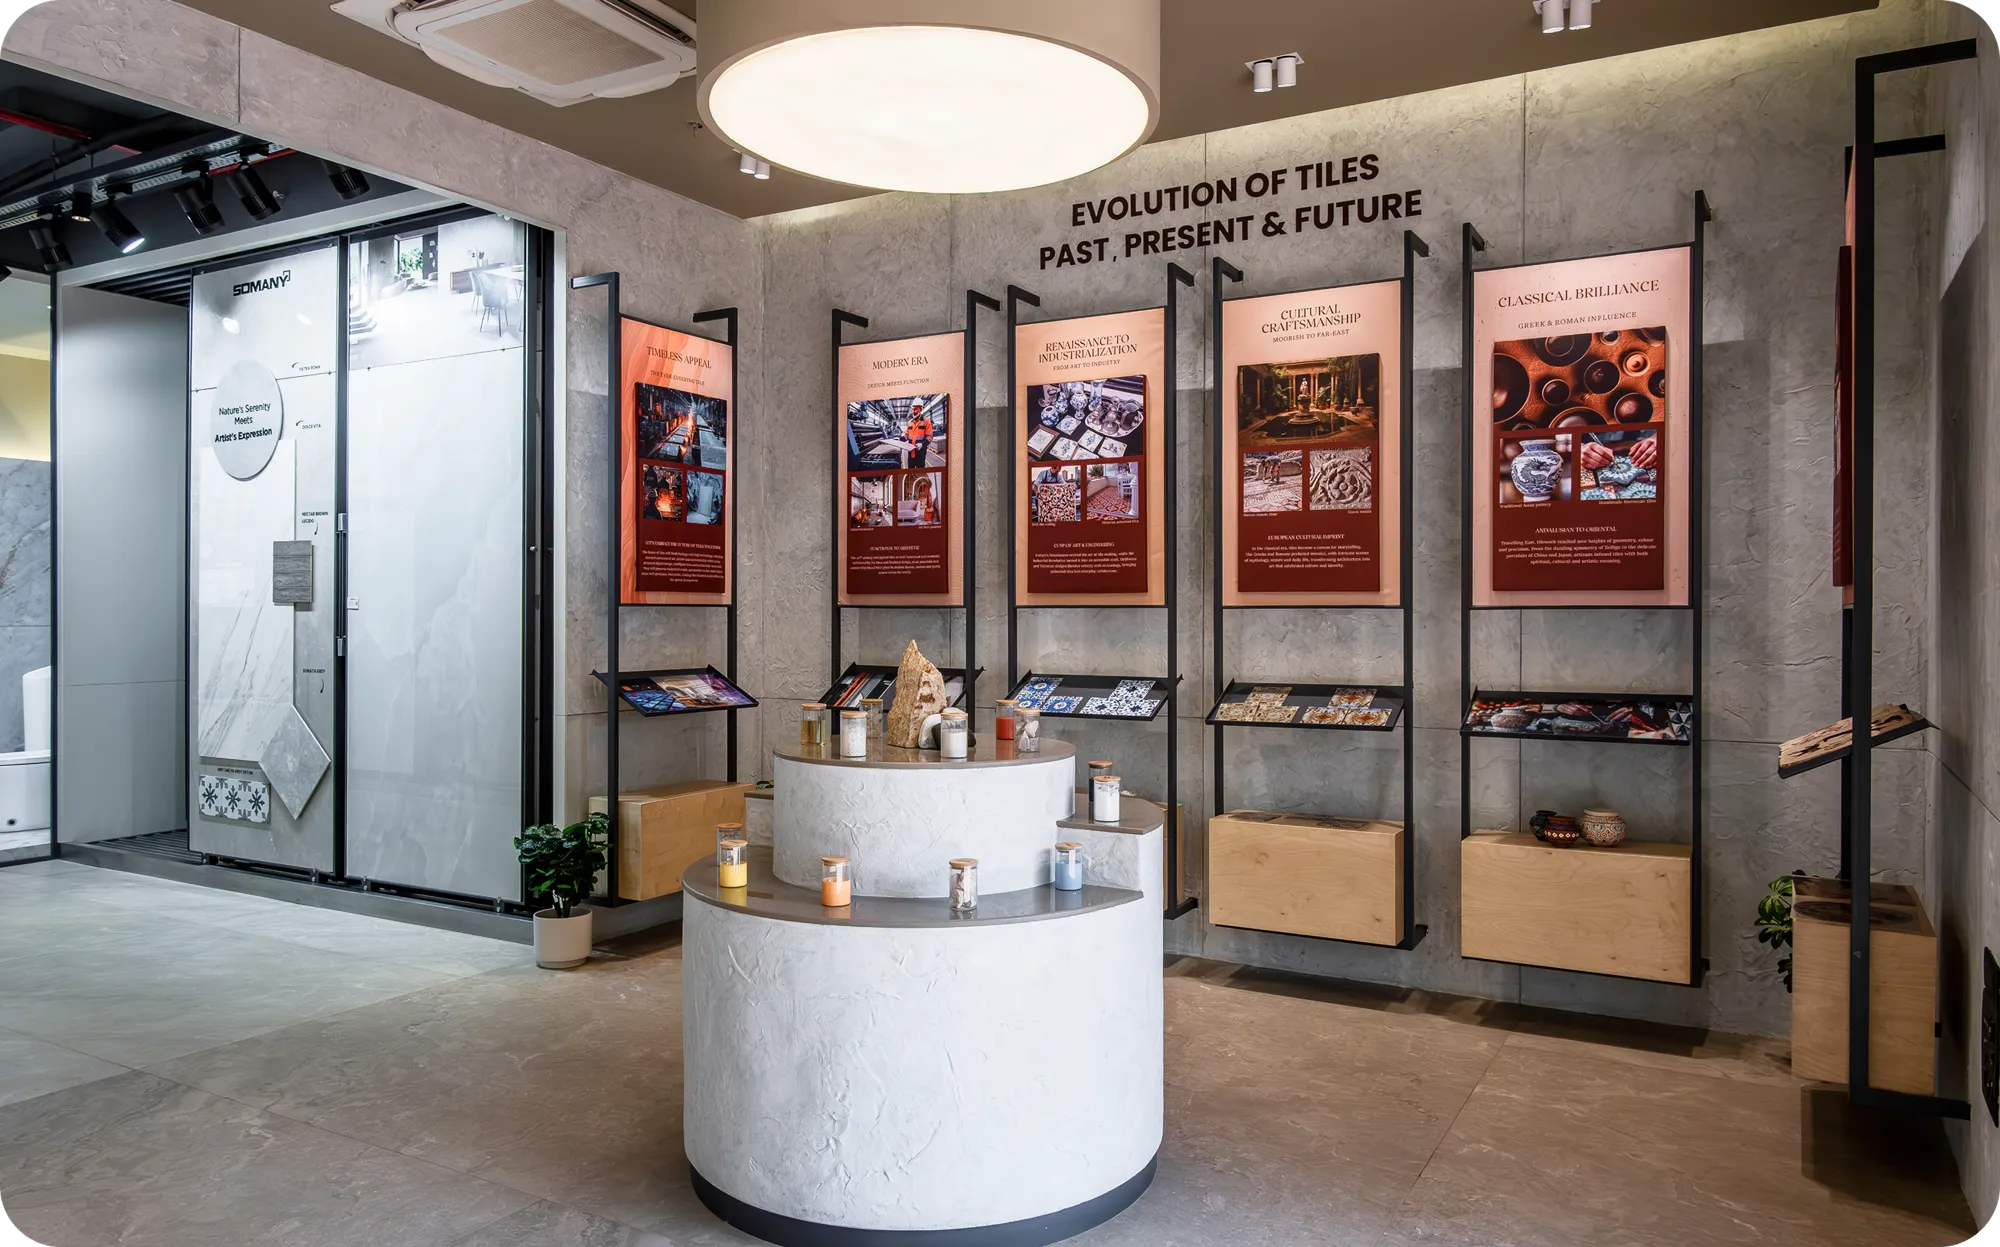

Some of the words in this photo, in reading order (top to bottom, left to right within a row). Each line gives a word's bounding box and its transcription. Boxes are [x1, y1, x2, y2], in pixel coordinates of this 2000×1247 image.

[1071, 177, 1238, 227] EVOLUTION
[1245, 168, 1288, 199] OF
[1295, 153, 1379, 191] TILES
[1039, 237, 1118, 270] PAST,
[1125, 214, 1254, 259] PRESENT
[1261, 211, 1286, 237] &
[1295, 189, 1423, 233] FUTURE
[232, 271, 290, 296] SOMANY
[1498, 289, 1572, 308] CLASSICAL
[1575, 279, 1659, 300] BRILLIANCE
[1280, 304, 1341, 320] CULTURAL
[1518, 321, 1545, 329] GREEK
[1554, 316, 1585, 326] ROMAN
[1588, 311, 1637, 322] INFLUENCE
[1261, 312, 1361, 334] CRAFTSMANSHIP
[1046, 336, 1112, 352] RENAISSANCE
[1114, 334, 1130, 344] TO
[1273, 334, 1304, 343] MOORISH
[1317, 329, 1350, 338] FAR-EAST
[646, 346, 682, 363] TIMELESS
[684, 355, 712, 369] APPEAL
[1039, 344, 1138, 363] INDUSTRIALIZATION
[872, 357, 910, 370] MODERN
[911, 356, 928, 365] ERA
[1091, 359, 1120, 367] INDUSTRY
[219, 405, 243, 416] Nature's
[245, 402, 271, 413] Serenity
[234, 416, 253, 425] Meets
[215, 431, 237, 443] Artist's
[238, 428, 272, 441] Expression
